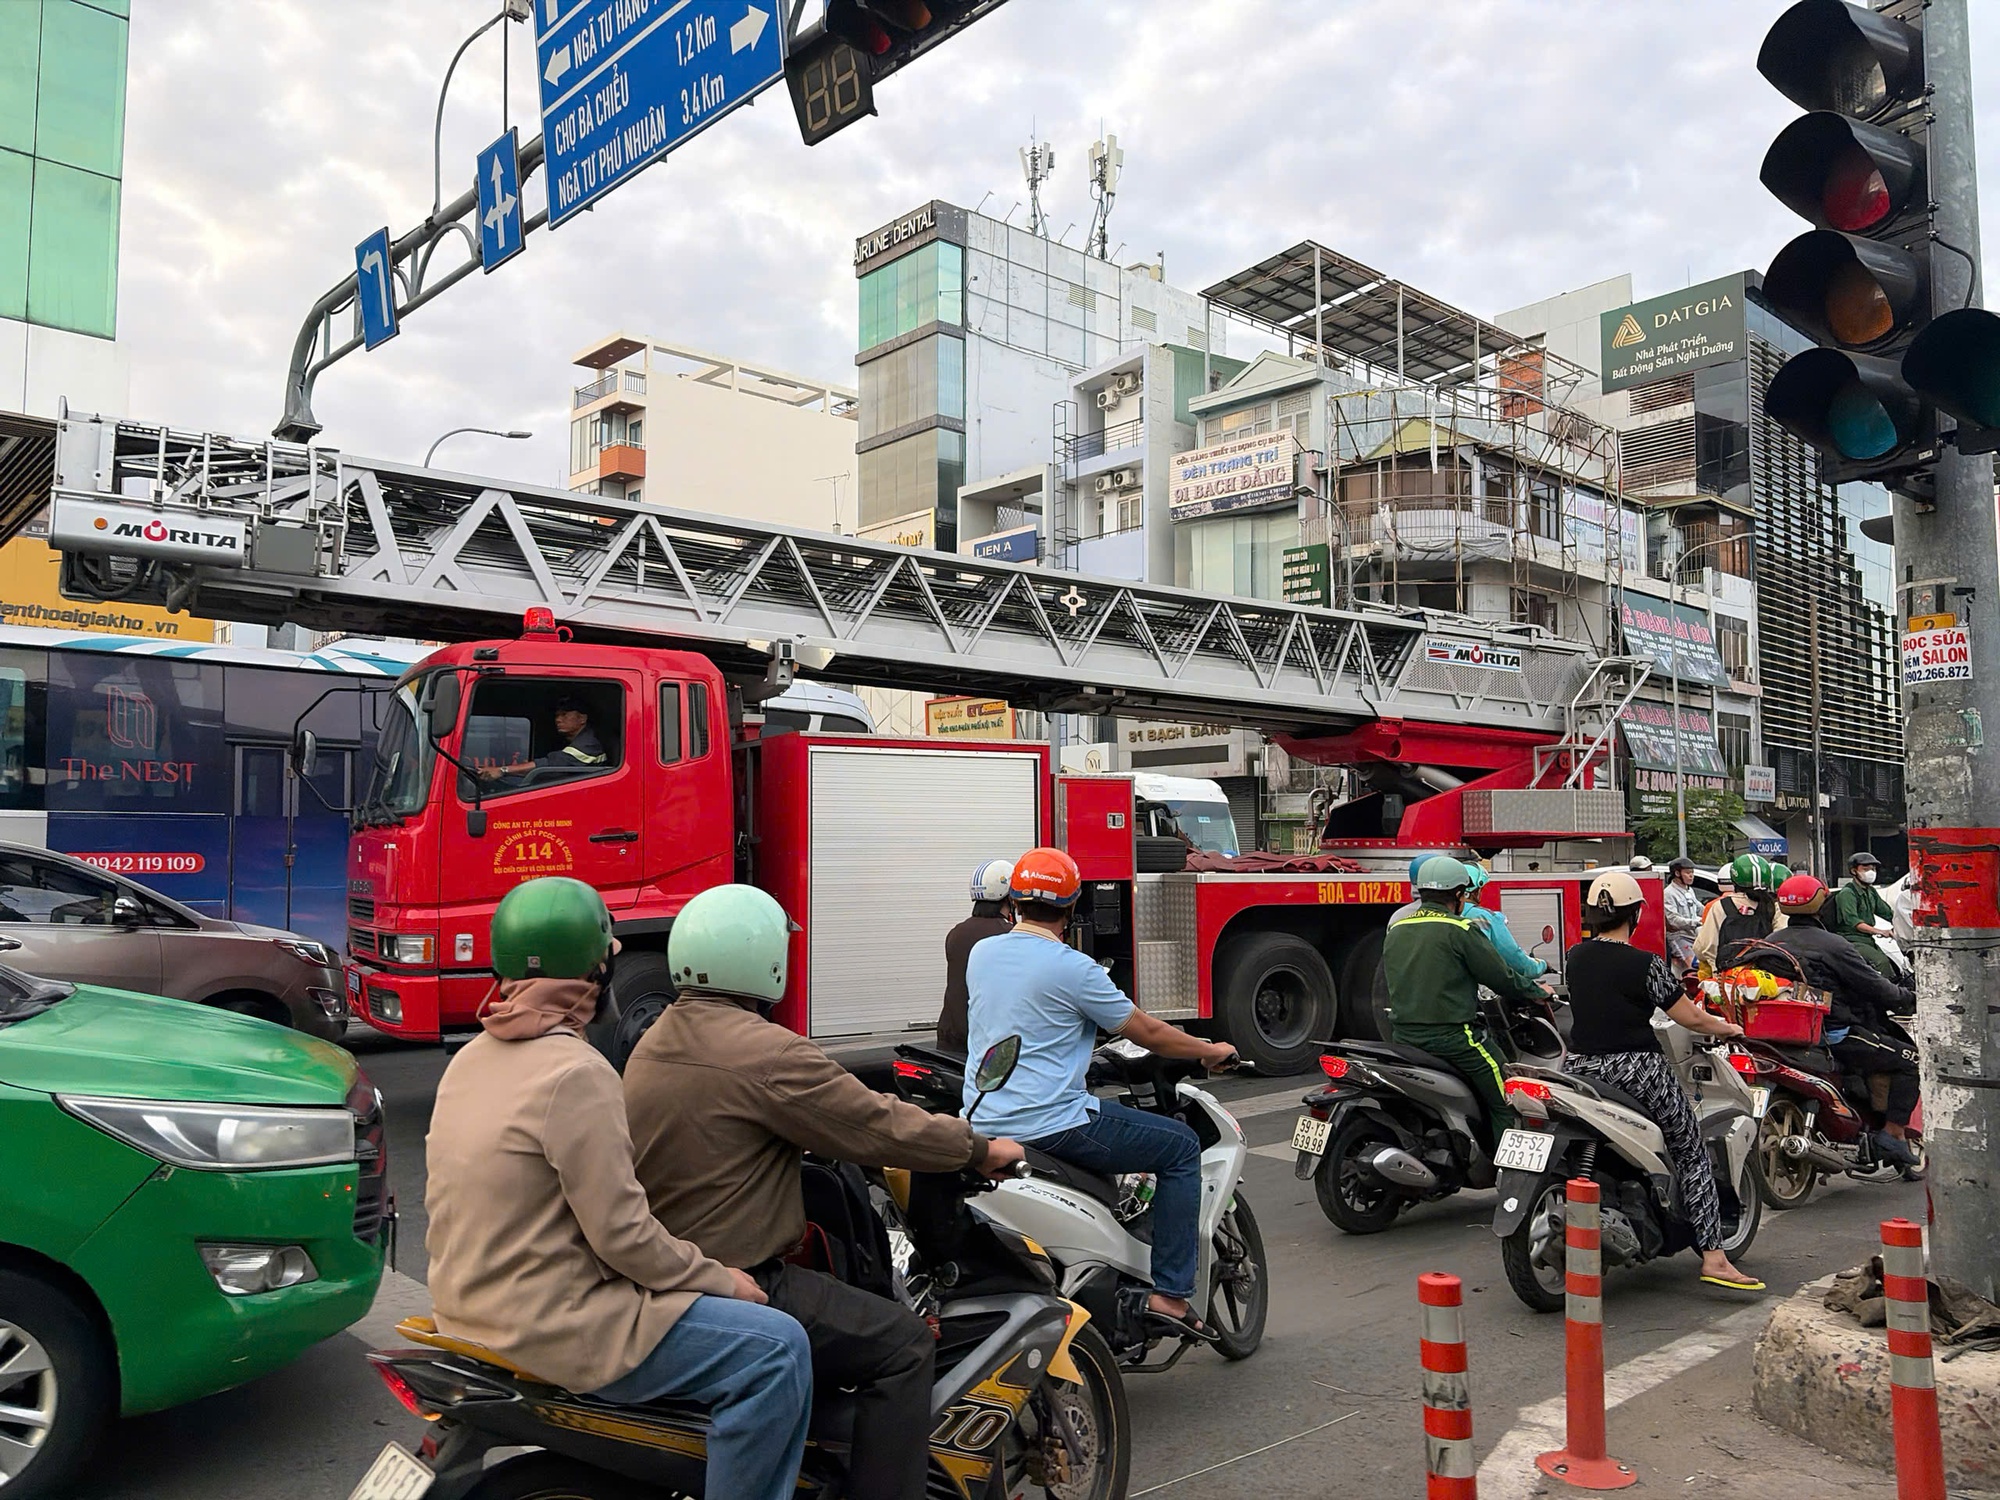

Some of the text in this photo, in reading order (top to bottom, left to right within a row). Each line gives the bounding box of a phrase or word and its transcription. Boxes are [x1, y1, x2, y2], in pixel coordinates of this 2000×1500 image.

[573, 16, 597, 69] NGÃ
[598, 4, 613, 48] TƯ
[676, 14, 717, 67] 1,2 Km
[555, 63, 629, 156] CHỢ BÀ CHIỂU
[681, 73, 725, 125] 3,4 Km
[558, 105, 667, 210] NGÃ TƯ PHÚ NHUẬN
[853, 231, 889, 264] AIRLINE
[893, 209, 935, 244] DENTAL
[1654, 295, 1733, 329] DATGIA
[1635, 333, 1708, 361] Nhà Phát Triển
[1612, 366, 1628, 380] Bất
[1630, 360, 1654, 375] Động
[1701, 341, 1734, 357] Dưỡng
[1174, 486, 1190, 503] 91
[113, 520, 236, 549] MORITA
[1426, 639, 1458, 649] Ladder
[1903, 629, 1967, 652] BỌC SỬA
[1454, 645, 1520, 667] MORITA
[1904, 647, 1968, 669] NỆM SALON
[1904, 665, 1969, 684] 0902.266.872
[1128, 730, 1143, 743] 91
[1147, 726, 1185, 743] BẠCH
[60, 757, 199, 783] The NEST
[511, 821, 521, 829] AN
[522, 821, 533, 829] TP.
[523, 829, 537, 837] SÁT
[538, 830, 557, 841] PCCC
[515, 842, 553, 861] 114
[1757, 843, 1770, 852] CAO
[137, 857, 162, 871] 119
[167, 857, 196, 871] 109
[1318, 882, 1345, 904] 50A
[1359, 882, 1402, 904] 012.78
[1300, 1119, 1326, 1137] 59-Y3
[1294, 1133, 1324, 1153] 639.98
[1508, 1133, 1545, 1152] 59-S2
[1499, 1148, 1543, 1171] 703.11
[929, 1404, 1010, 1451] 10
